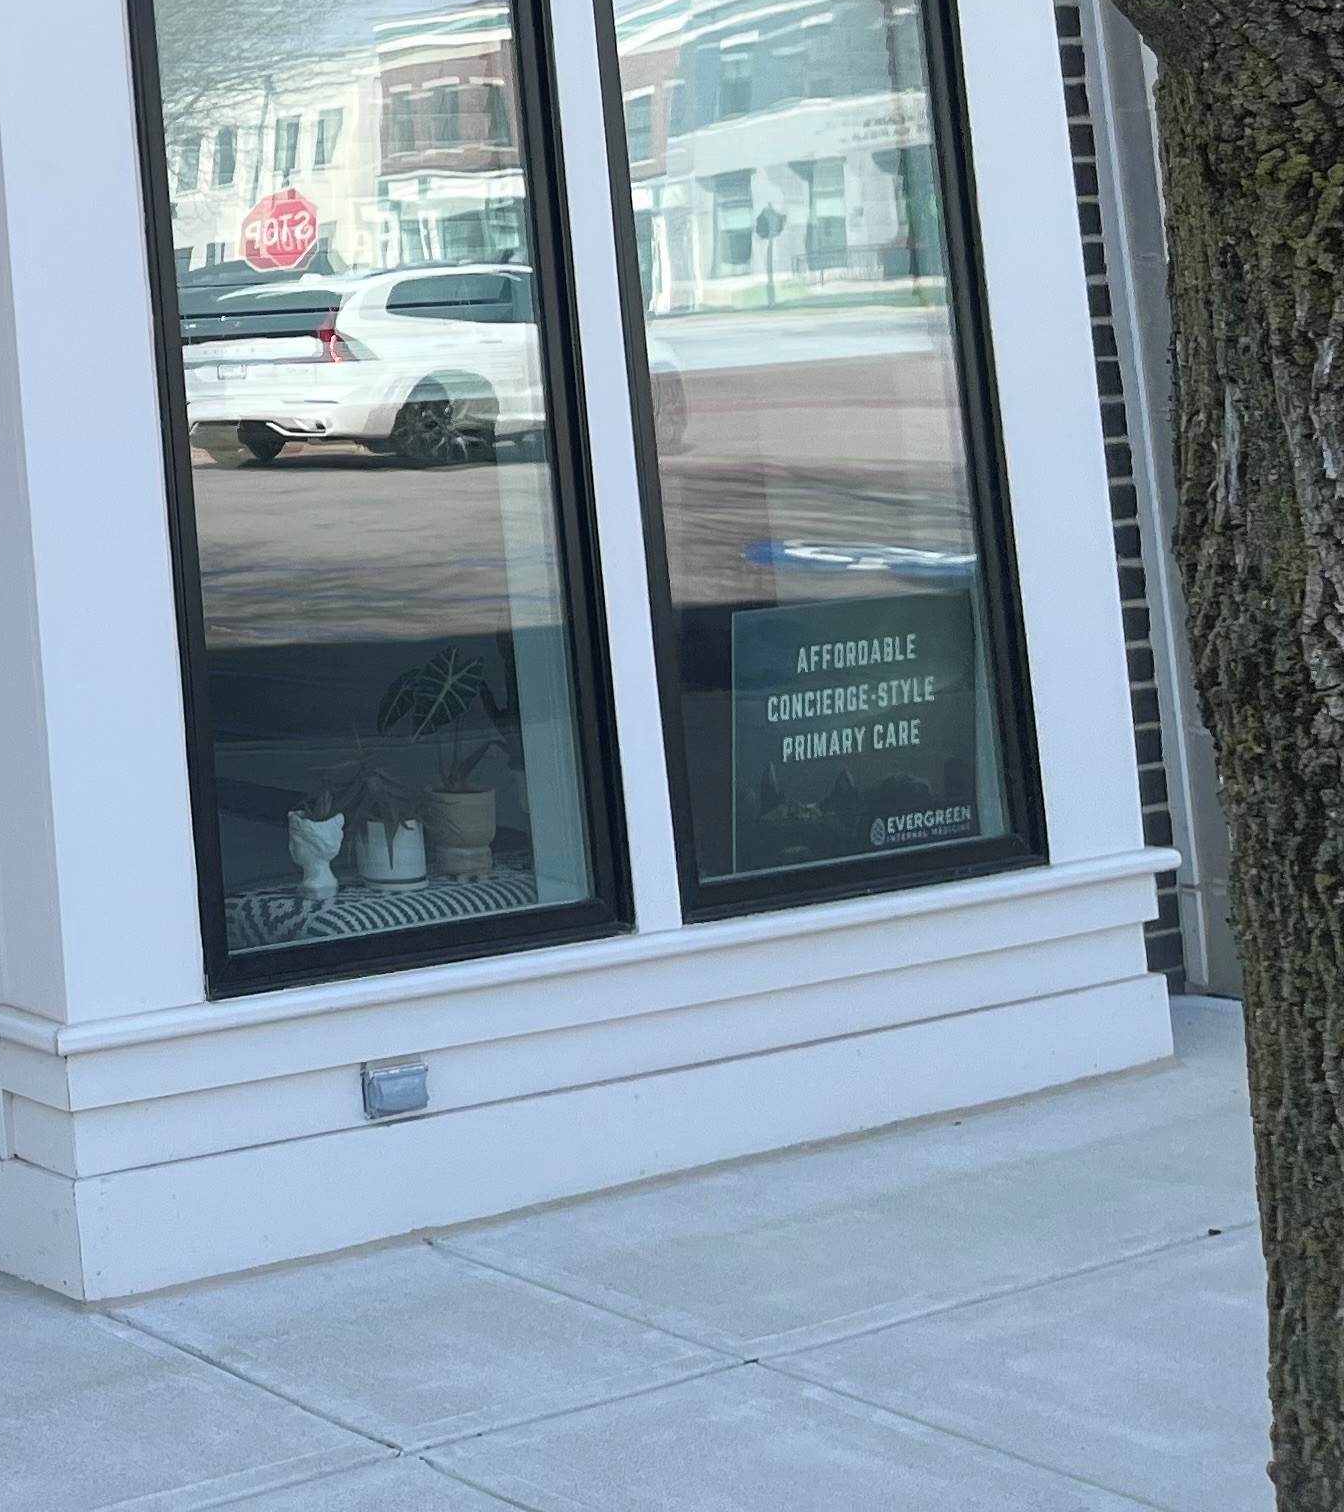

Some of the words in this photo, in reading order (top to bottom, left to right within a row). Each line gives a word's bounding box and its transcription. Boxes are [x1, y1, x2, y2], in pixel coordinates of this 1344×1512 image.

[797, 633, 917, 674] AFFORDABLE
[767, 676, 936, 723] CONCIERGE-STYLE
[782, 726, 866, 762] PRIMARY
[873, 719, 921, 750] CARE
[886, 806, 972, 834] EVERGREEN
